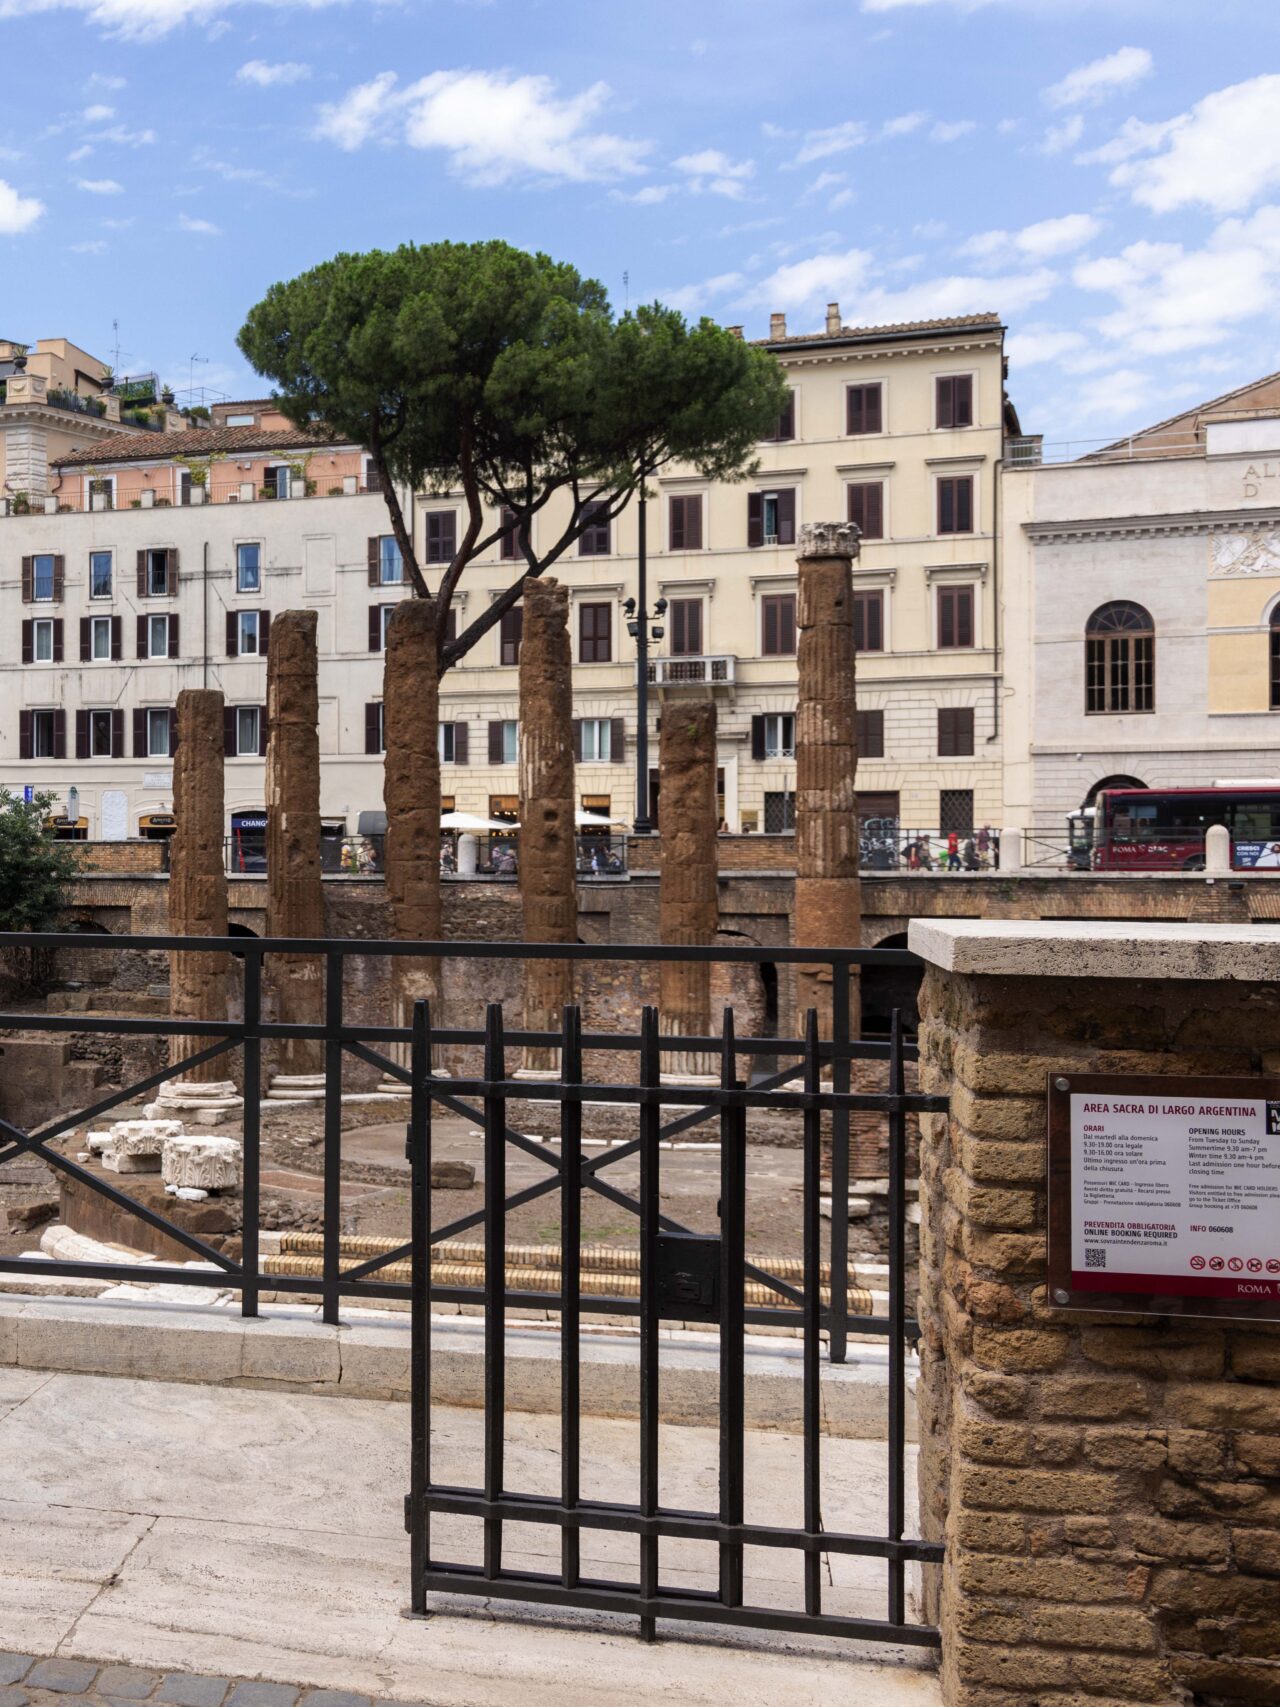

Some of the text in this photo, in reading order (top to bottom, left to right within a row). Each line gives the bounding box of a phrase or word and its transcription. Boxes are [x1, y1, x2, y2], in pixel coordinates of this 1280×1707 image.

[241, 819, 268, 827] CHANG
[1083, 1103, 1257, 1117] AREA SACRA DI LARGO ARGENTINA
[1205, 1137, 1229, 1145] Tuesday
[1238, 1138, 1260, 1146] Sunday
[1125, 1142, 1143, 1150] legale
[1104, 1157, 1128, 1165] ingresso
[1084, 1221, 1175, 1231] PREVENDITA OBBLIGATORIA
[1208, 1225, 1234, 1233] 060608
[1143, 1231, 1178, 1239] REQUIRED
[1237, 1284, 1272, 1294] ROMA
